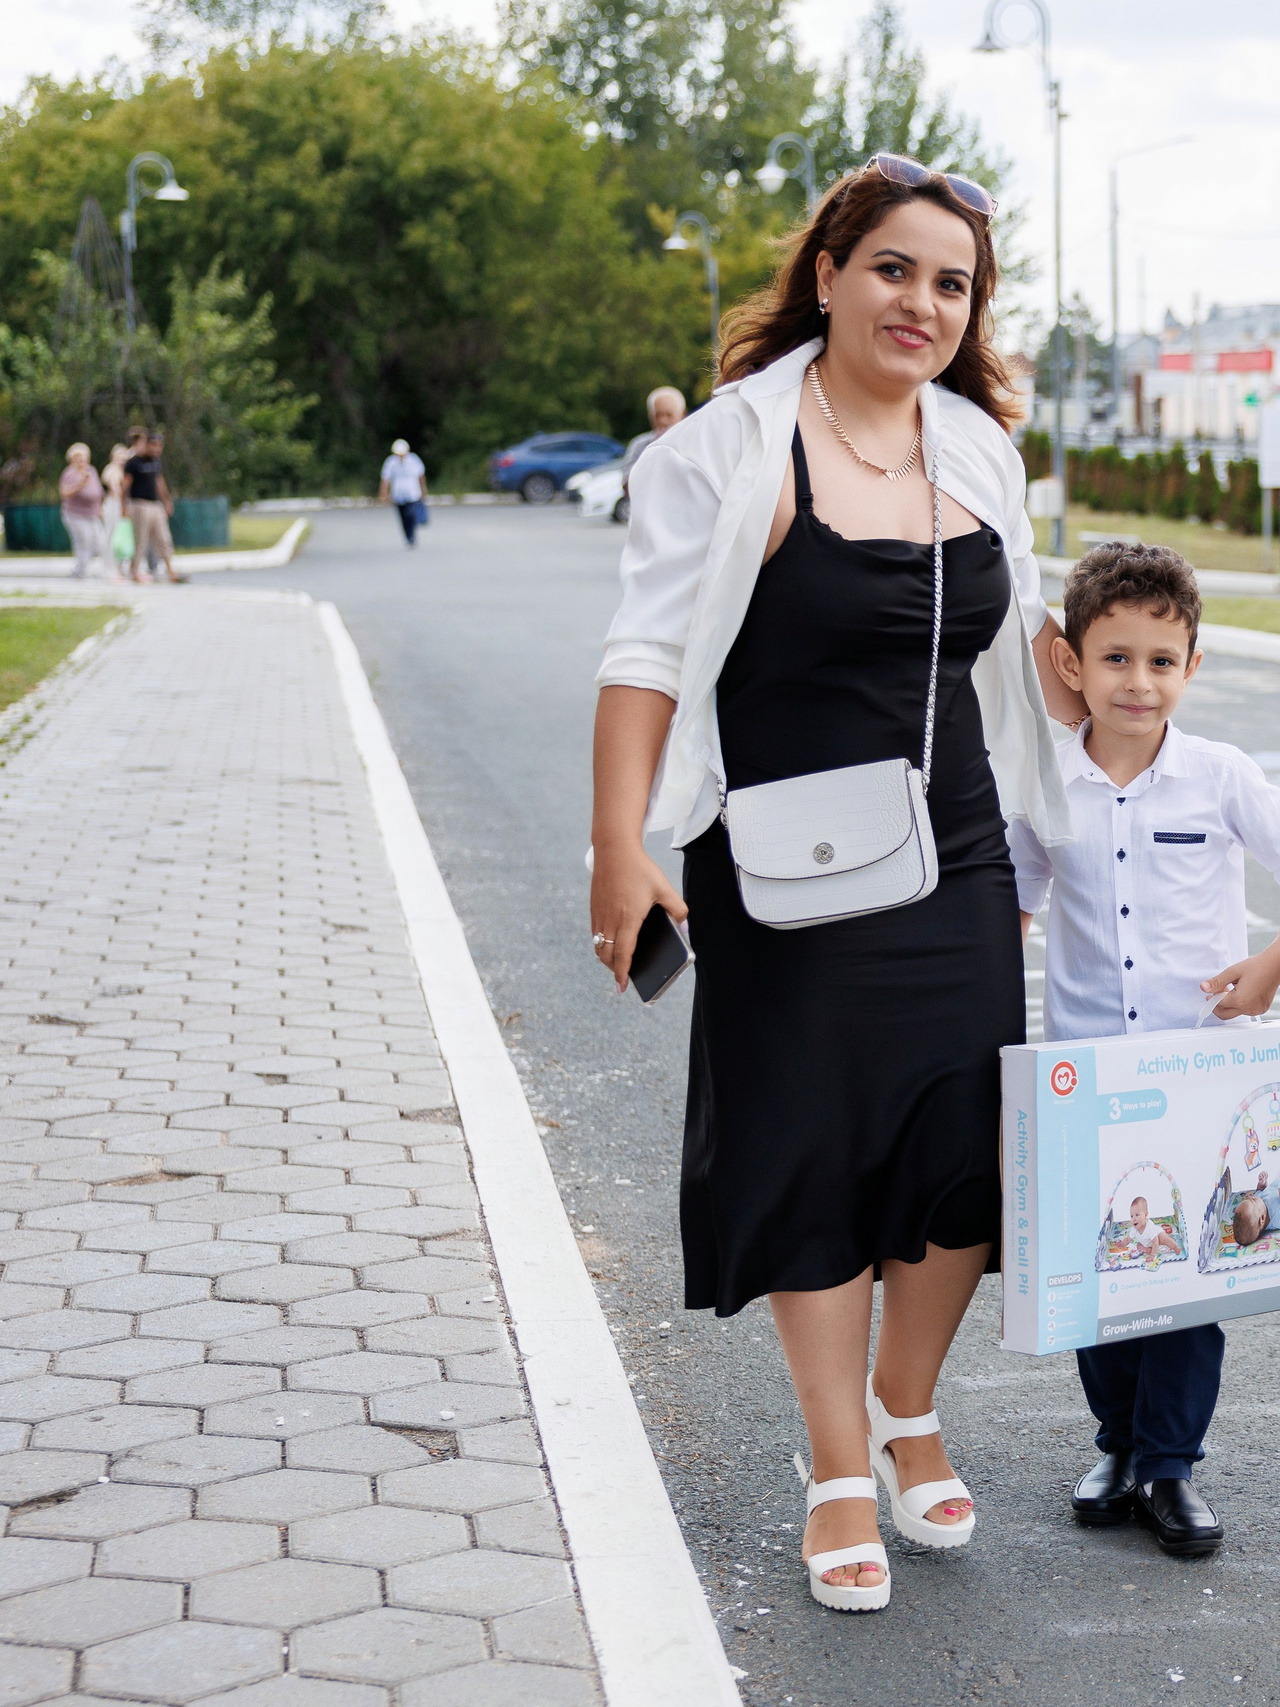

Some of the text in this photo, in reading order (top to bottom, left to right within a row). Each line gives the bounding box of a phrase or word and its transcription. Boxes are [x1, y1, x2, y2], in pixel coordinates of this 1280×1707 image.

[1136, 1054, 1188, 1076] Activity
[1194, 1052, 1225, 1072] Gym
[1230, 1048, 1245, 1064] To
[1110, 1097, 1121, 1120] 3
[1123, 1103, 1138, 1111] Ways
[1148, 1100, 1162, 1109] play!
[1015, 1109, 1029, 1295] Activity Gym & Ball Pit
[1049, 1274, 1081, 1286] DEVELOPS
[1102, 1314, 1173, 1336] Grow-With-Me
